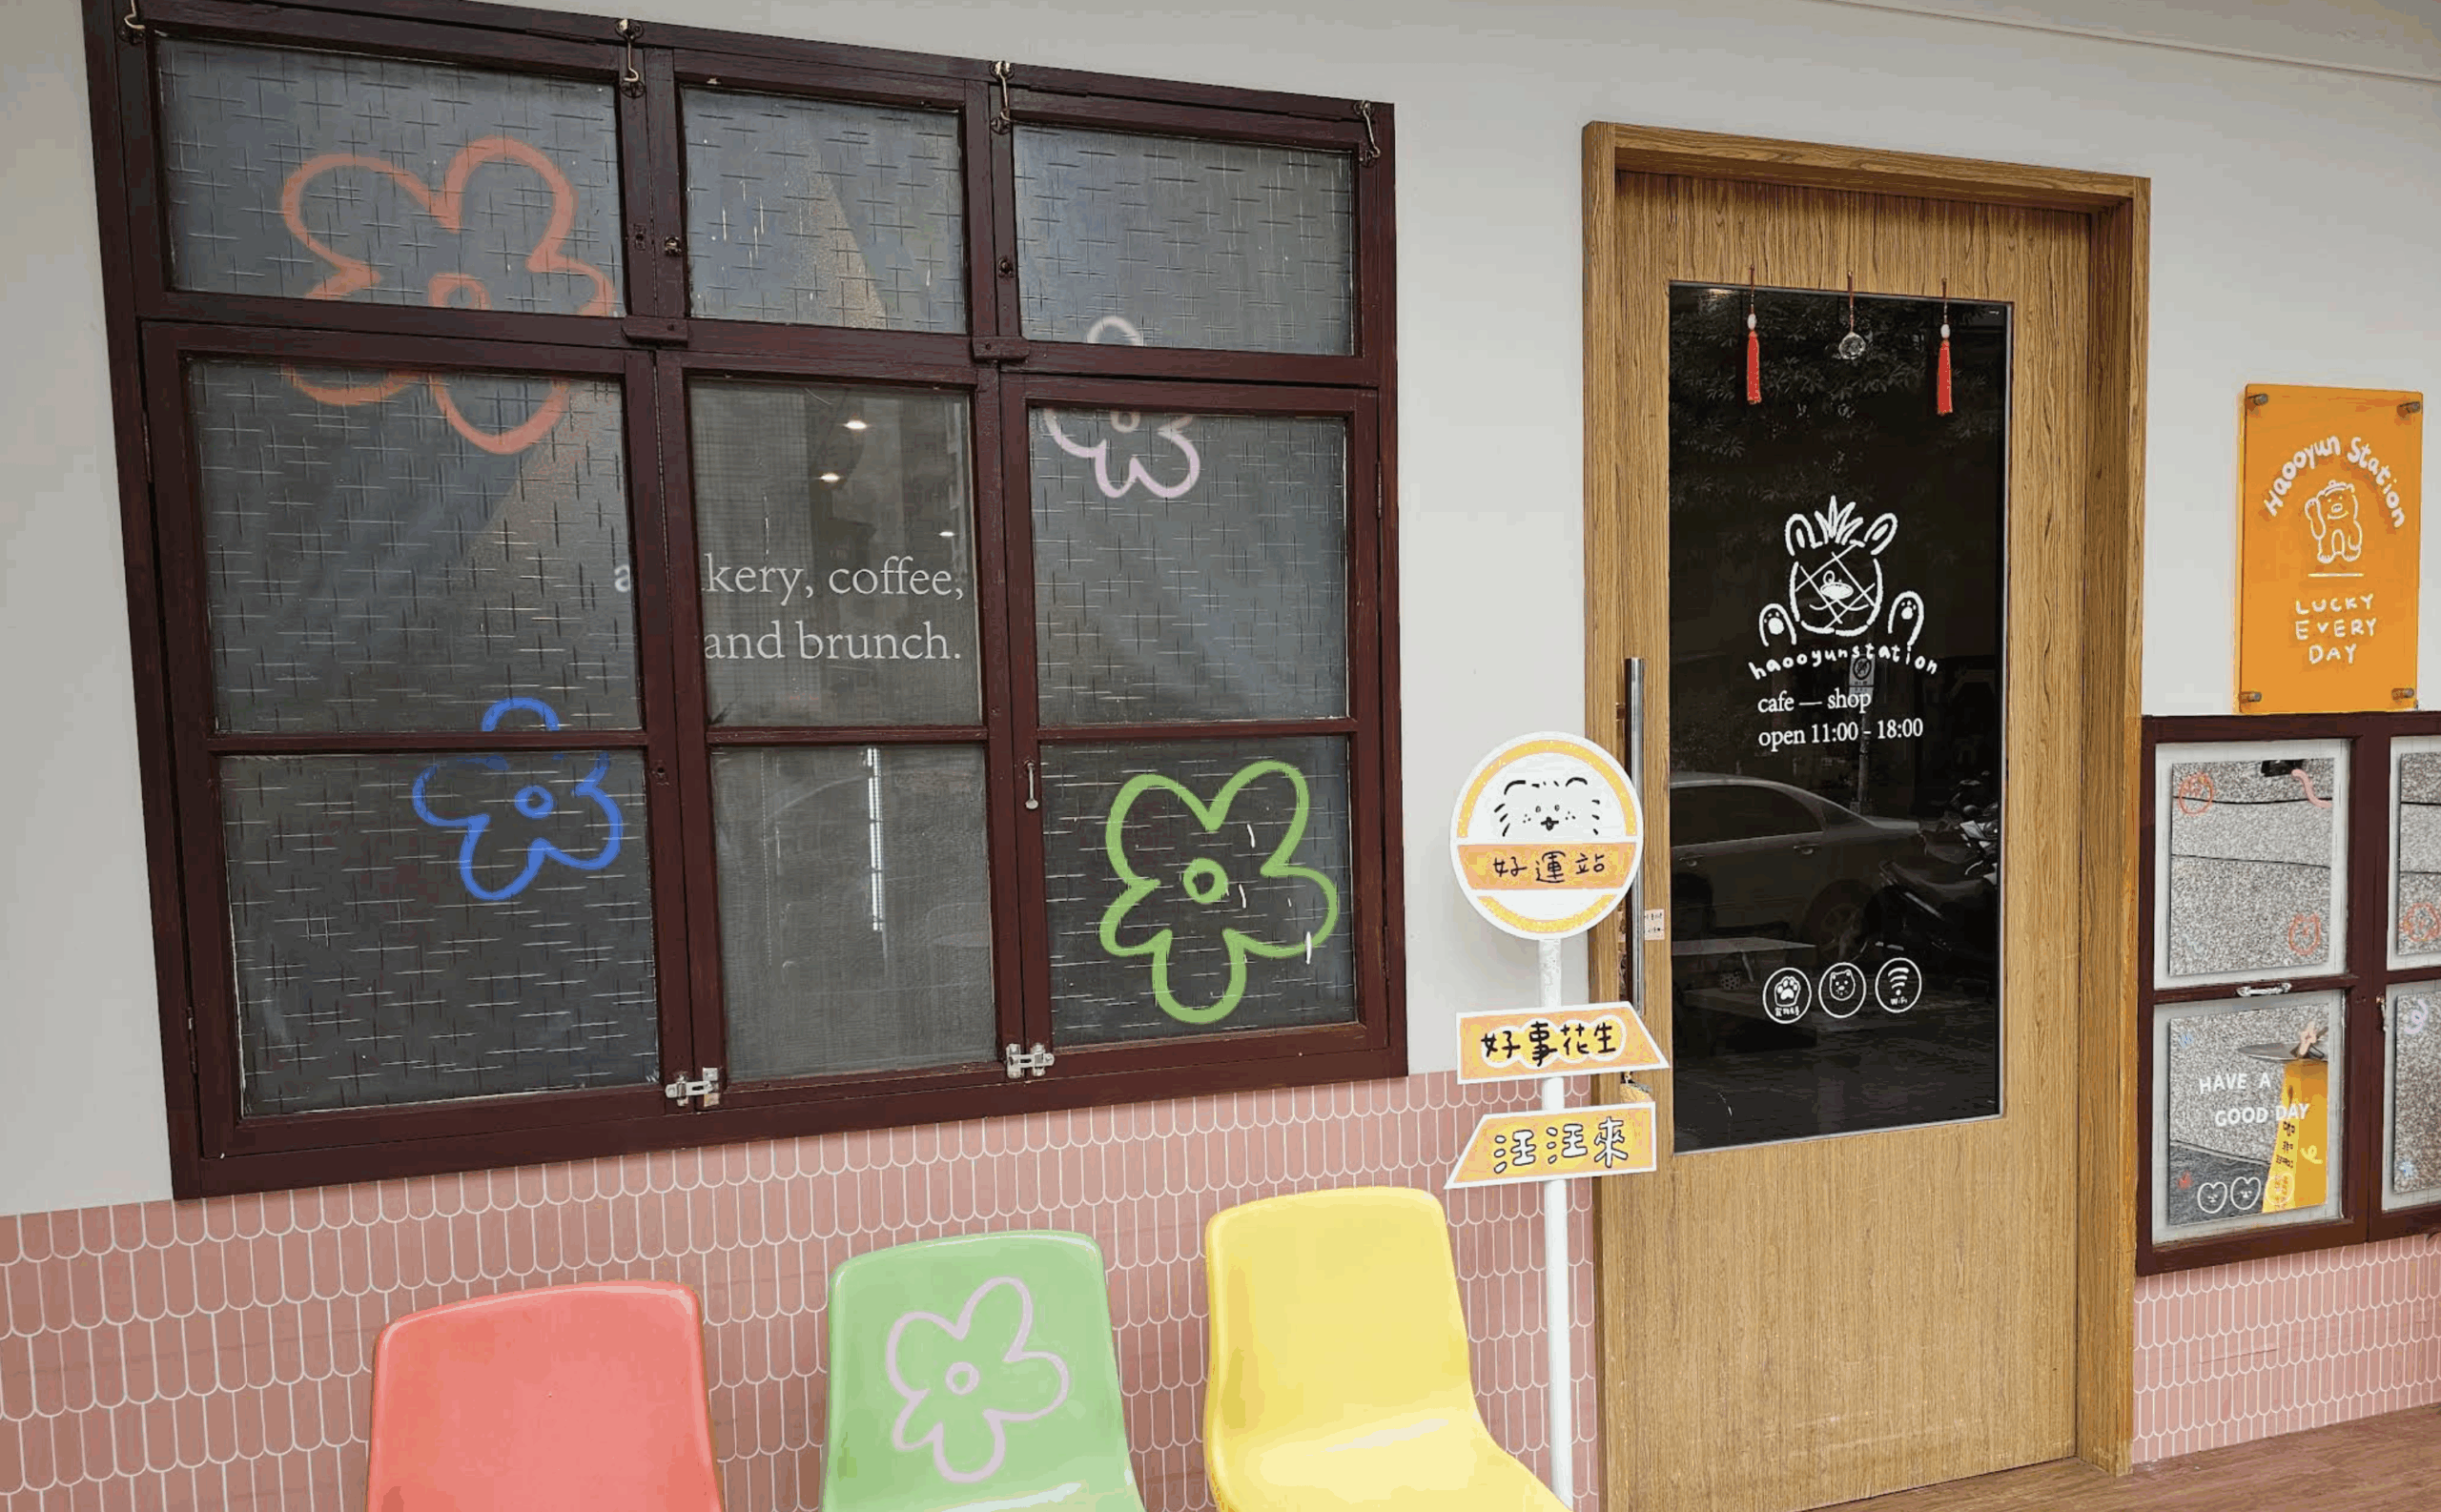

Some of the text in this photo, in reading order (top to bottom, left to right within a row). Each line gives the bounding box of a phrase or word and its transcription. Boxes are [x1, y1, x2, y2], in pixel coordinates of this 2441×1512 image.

[2264, 436, 2405, 528] Haooyun Station
[701, 552, 814, 605] kery,
[828, 555, 965, 601] coffee,
[2295, 593, 2374, 615] LUCKY
[704, 621, 962, 661] and brunch.
[2295, 618, 2377, 641] EVERY
[2308, 644, 2357, 664] DAY
[1757, 690, 1795, 713] cafe
[1827, 686, 1872, 714] shop
[1757, 730, 1806, 752] open
[1811, 722, 1858, 743] 11:00
[1877, 718, 1923, 740] 18:00
[1493, 850, 1605, 883] 好運站
[1481, 1021, 1616, 1067] 好事花生
[2198, 1073, 2271, 1094] HAVE A
[2215, 1103, 2309, 1127] GOOD DAY
[1493, 1116, 1629, 1174] 汪汪來
